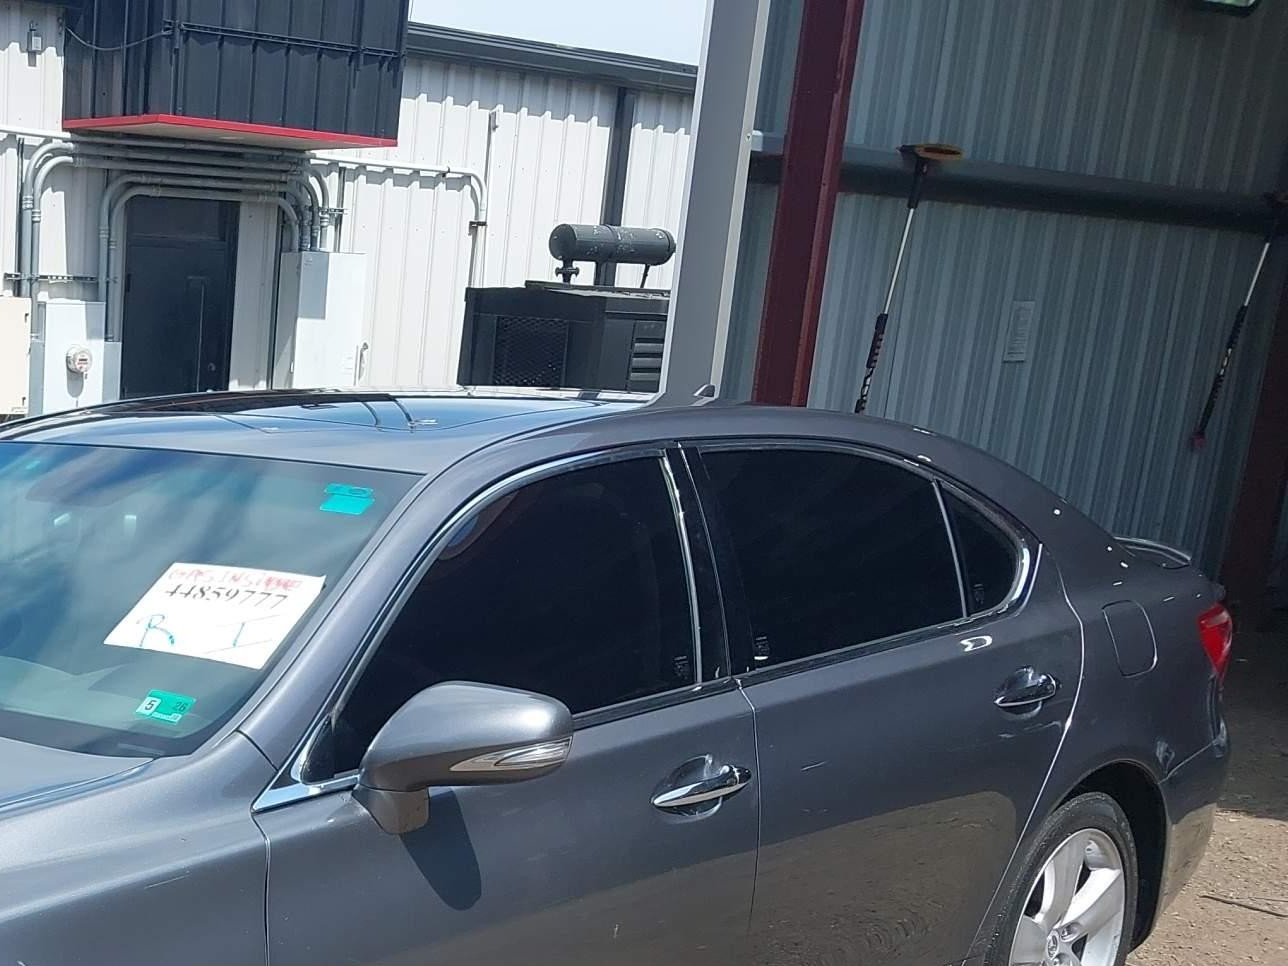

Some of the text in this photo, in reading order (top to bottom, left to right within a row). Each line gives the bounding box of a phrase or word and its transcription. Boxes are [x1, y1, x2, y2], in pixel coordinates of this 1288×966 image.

[165, 583, 289, 609] 44859777
[138, 613, 175, 648] R
[144, 699, 189, 712] 5 26
